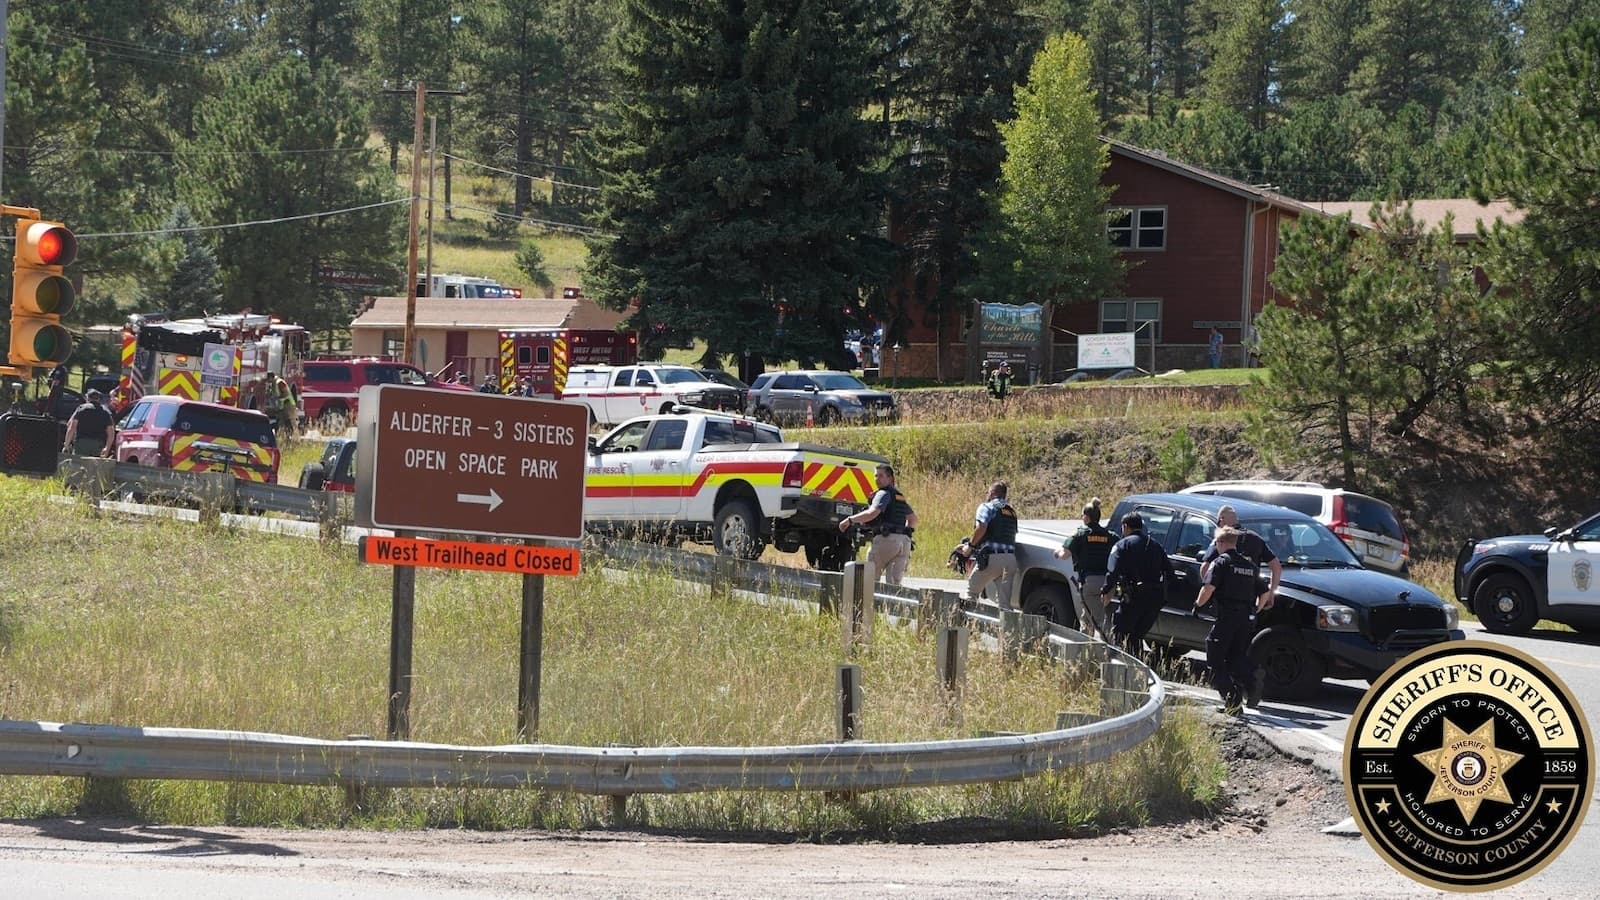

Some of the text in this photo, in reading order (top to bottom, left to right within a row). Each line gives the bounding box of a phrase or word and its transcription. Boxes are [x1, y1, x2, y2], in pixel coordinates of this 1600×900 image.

[983, 322, 1021, 332] Church
[1009, 332, 1036, 342] Hills
[390, 411, 471, 437] ALDERFER
[494, 420, 503, 440] 3
[513, 422, 574, 446] SISTERS
[405, 448, 557, 480] OPEN SPACE PARK
[377, 540, 572, 572] West Trailhead Closed
[1233, 567, 1254, 576] POLICE
